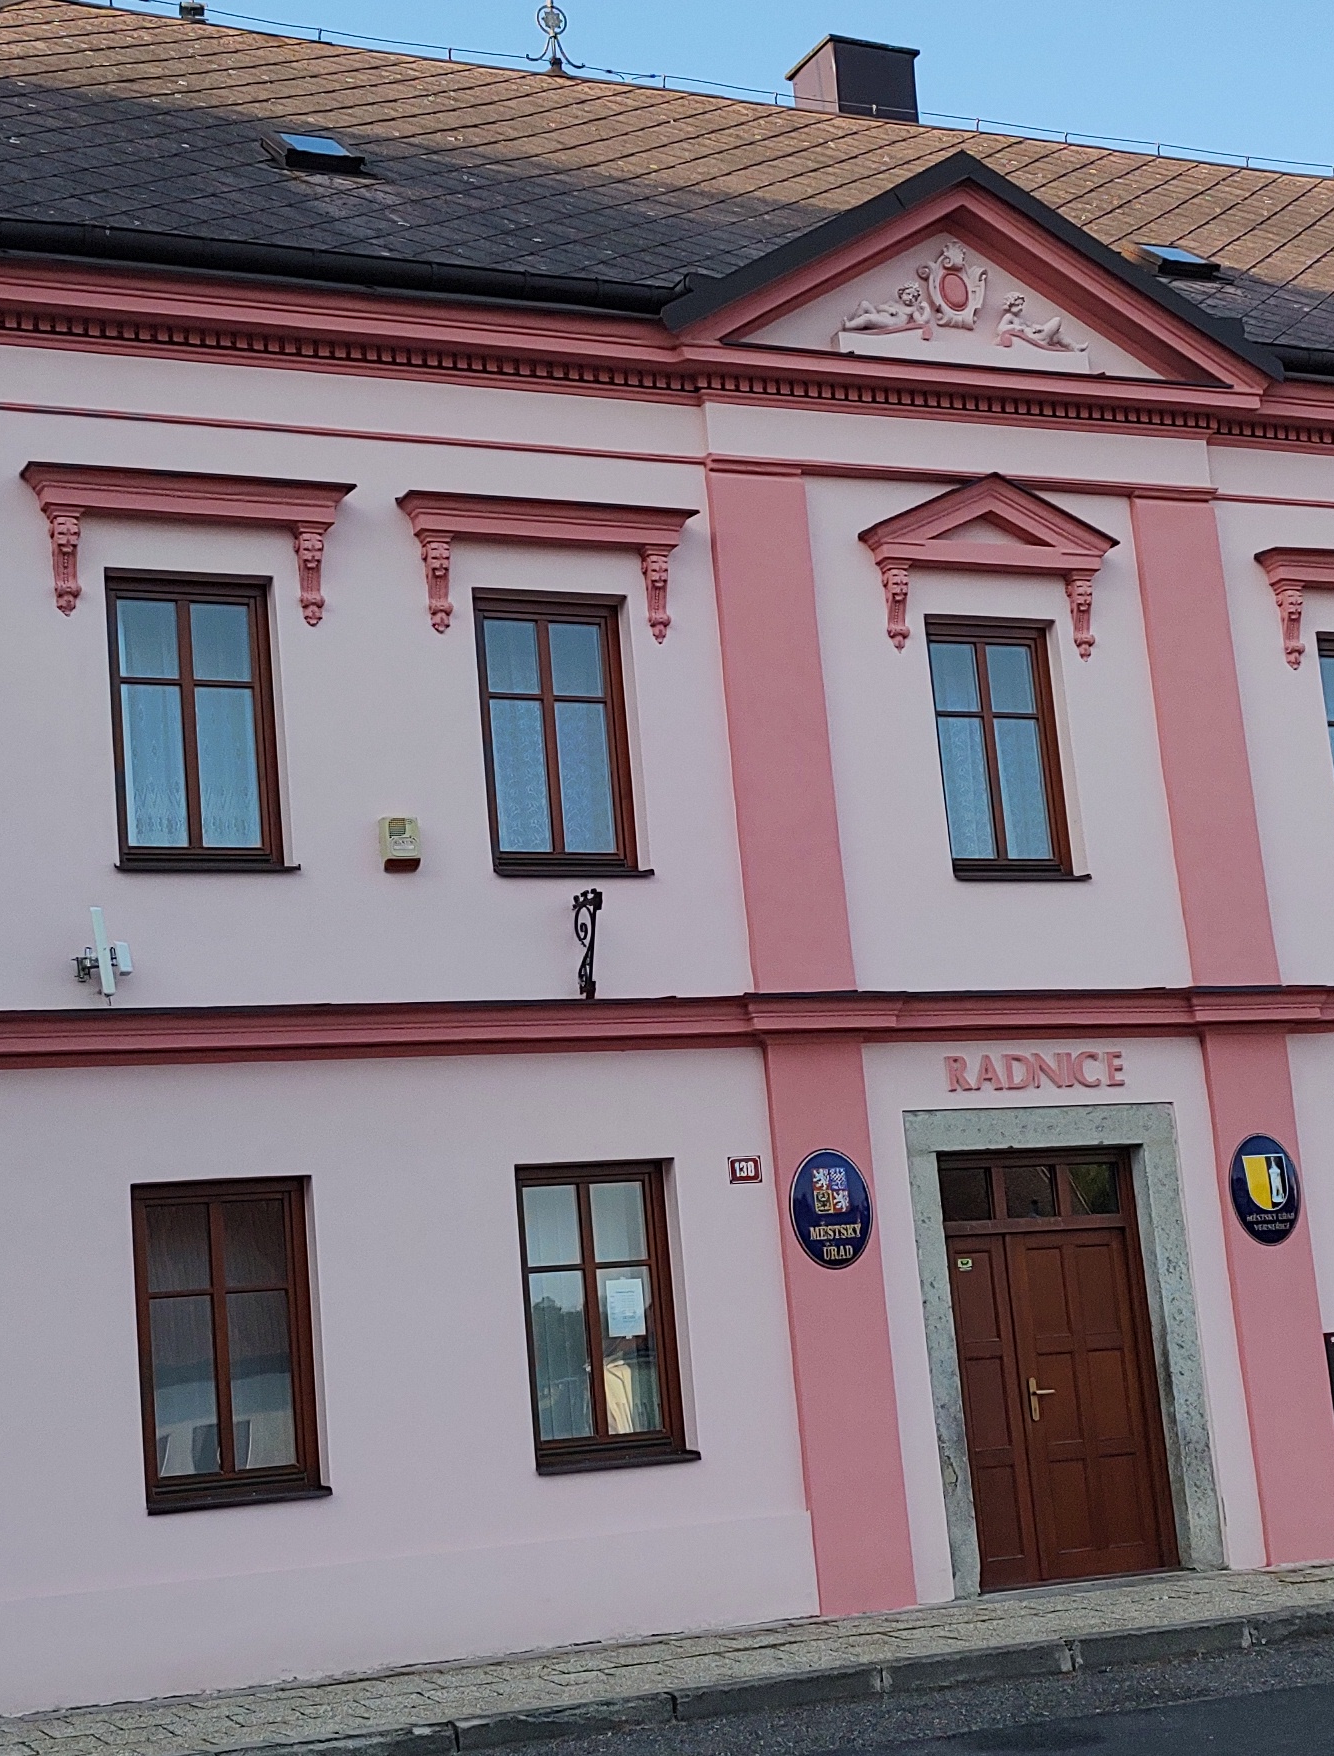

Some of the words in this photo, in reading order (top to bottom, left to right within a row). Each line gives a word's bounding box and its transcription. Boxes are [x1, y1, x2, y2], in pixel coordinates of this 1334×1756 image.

[944, 1051, 1126, 1092] RADNICE
[809, 1219, 862, 1241] MĚSTSKÝ
[823, 1242, 854, 1260] ÚŘAD
